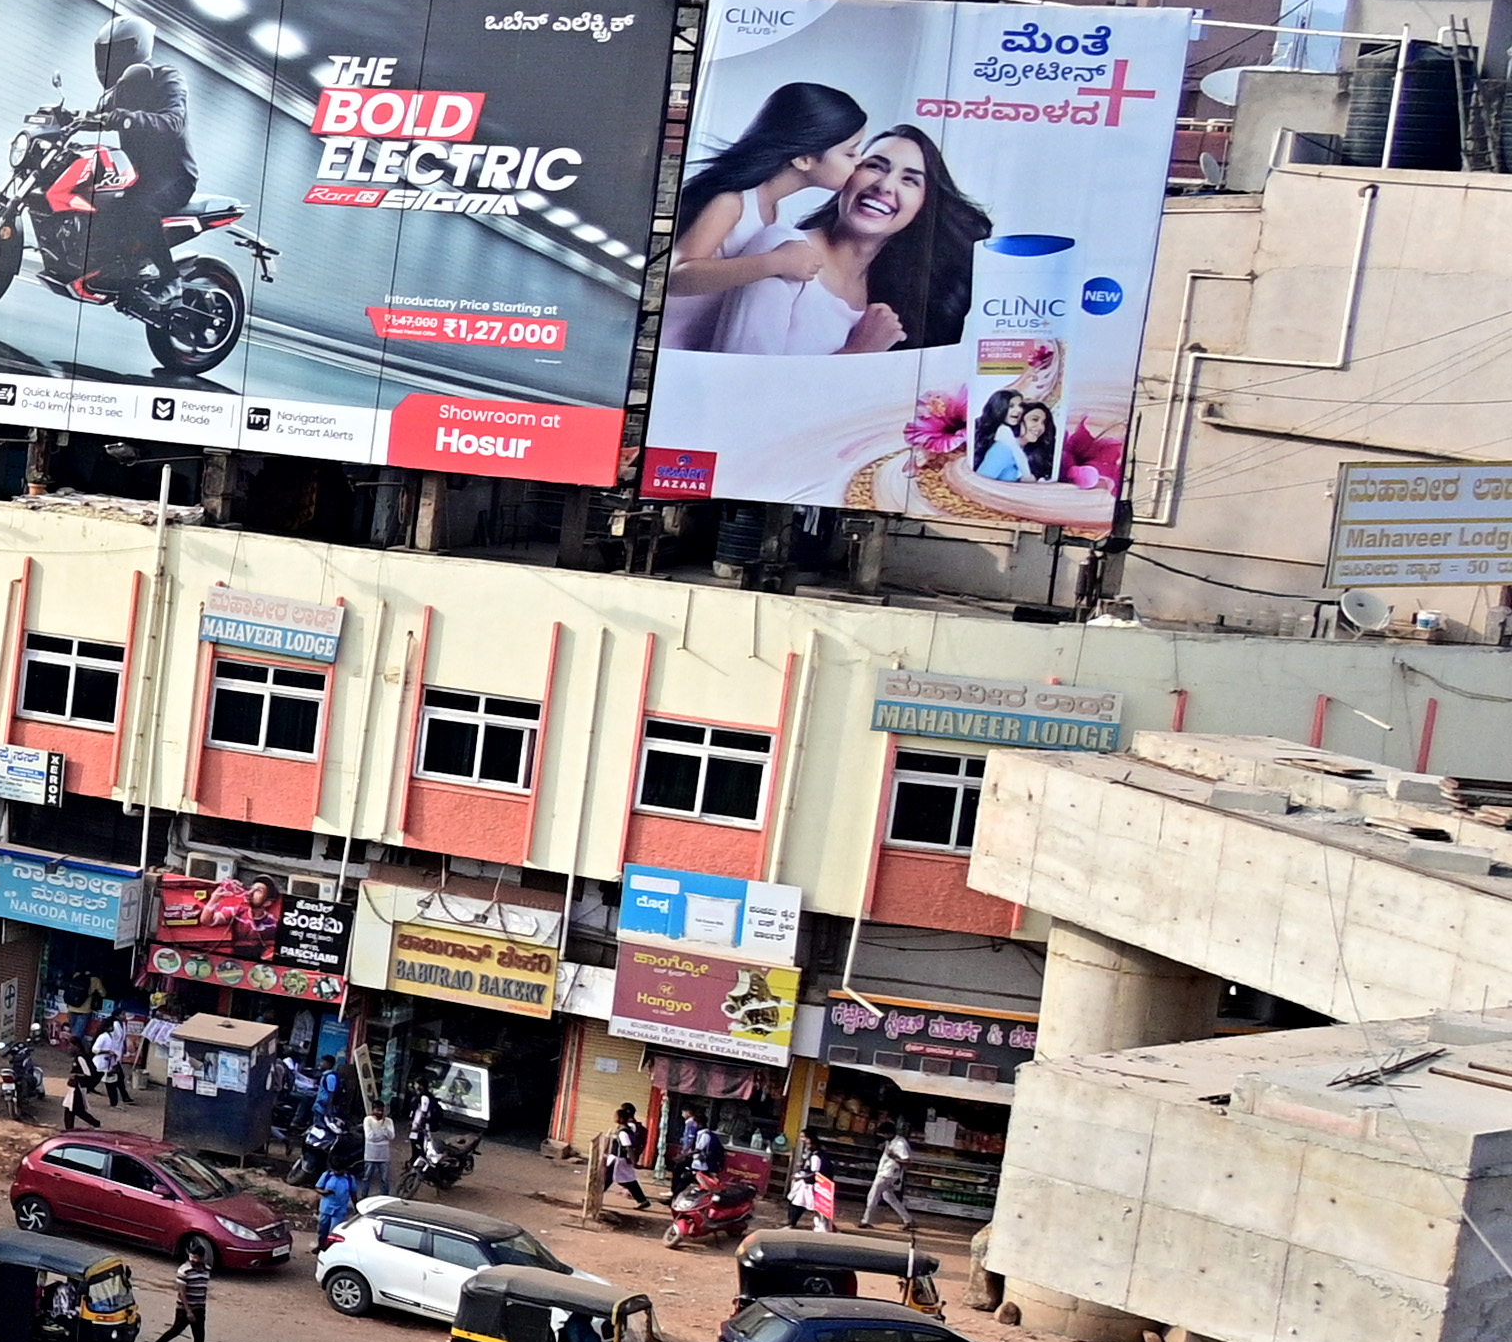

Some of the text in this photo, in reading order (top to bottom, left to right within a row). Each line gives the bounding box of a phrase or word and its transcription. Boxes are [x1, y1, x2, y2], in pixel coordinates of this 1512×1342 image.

[484, 11, 550, 31] ಒಬೆನ್
[725, 7, 795, 27] CLINIC
[1001, 22, 1111, 56] ಮೆಂತೆ
[328, 55, 398, 86] THE
[973, 56, 1107, 86] ಪ್ರೋಟೀನ್
[321, 89, 474, 138] BOLD
[915, 95, 1100, 125] ದಾಸವಾಳದ
[317, 137, 583, 191] ELECTRIC
[381, 189, 520, 217] SIGMA
[385, 294, 558, 317] Introductory Price Starting at
[983, 296, 1066, 318] CLINIC
[1085, 291, 1121, 302] NEW
[22, 386, 117, 405] Quick Acceleration
[181, 401, 224, 415] Reverse
[77, 405, 123, 419] in sec
[180, 414, 210, 427] Mode
[277, 410, 337, 427] Navigation
[439, 404, 561, 429] Showroom at
[276, 425, 354, 442] & Smart Alerts
[435, 427, 532, 459] Hosur
[655, 466, 709, 480] SMART
[1348, 471, 1461, 502] ಮಹಾವೀರ
[1346, 528, 1452, 548] Mahaveer
[1467, 560, 1489, 574] 50
[209, 592, 289, 621] ಮಹಾವೀರ
[202, 618, 335, 656] MAHAVEER LODGE
[885, 674, 1028, 707] ಮಹಾವೀರ
[876, 704, 1115, 750] MAHAVEER LODGE
[47, 755, 61, 805] XEROX
[9, 898, 68, 921] NAKODA
[31, 887, 108, 911] ಮೆಡಿಕಲ್
[283, 910, 344, 935] ಪಂಚಮಿ
[280, 945, 339, 965] PANCHAMI
[497, 945, 552, 974] ಬೇಕರಿ
[396, 959, 547, 1004] BABURAO BAKERY
[637, 992, 693, 1012] Hangyo
[616, 1028, 779, 1063] PANCHAMI DAIRY ICE CREAM PARLOUR
